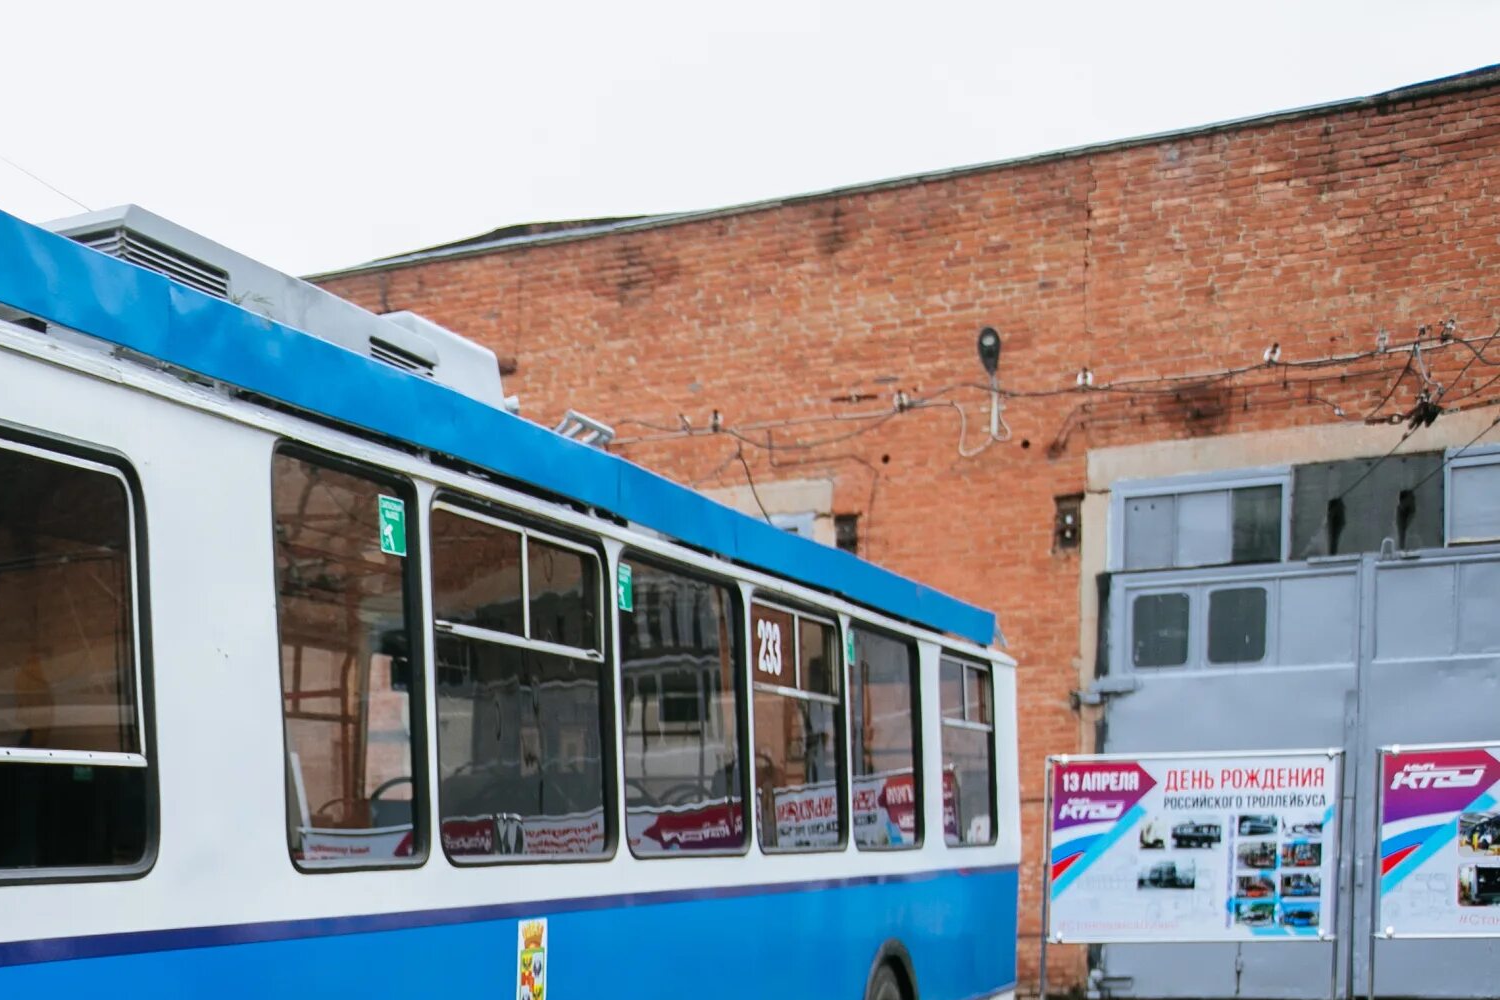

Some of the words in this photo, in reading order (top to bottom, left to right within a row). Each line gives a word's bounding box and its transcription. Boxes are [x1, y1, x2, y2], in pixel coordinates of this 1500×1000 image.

[757, 618, 782, 676] 233
[1062, 771, 1079, 792] 13
[1081, 770, 1139, 792] АПРЕЛЯ
[1164, 769, 1215, 792] ДЕНЬ
[1220, 767, 1325, 790] РОЖДЕНИЯ
[1163, 794, 1243, 810] РОССИЙСКОГО
[1244, 792, 1326, 808] ТРОЛЛЕЙБУСА
